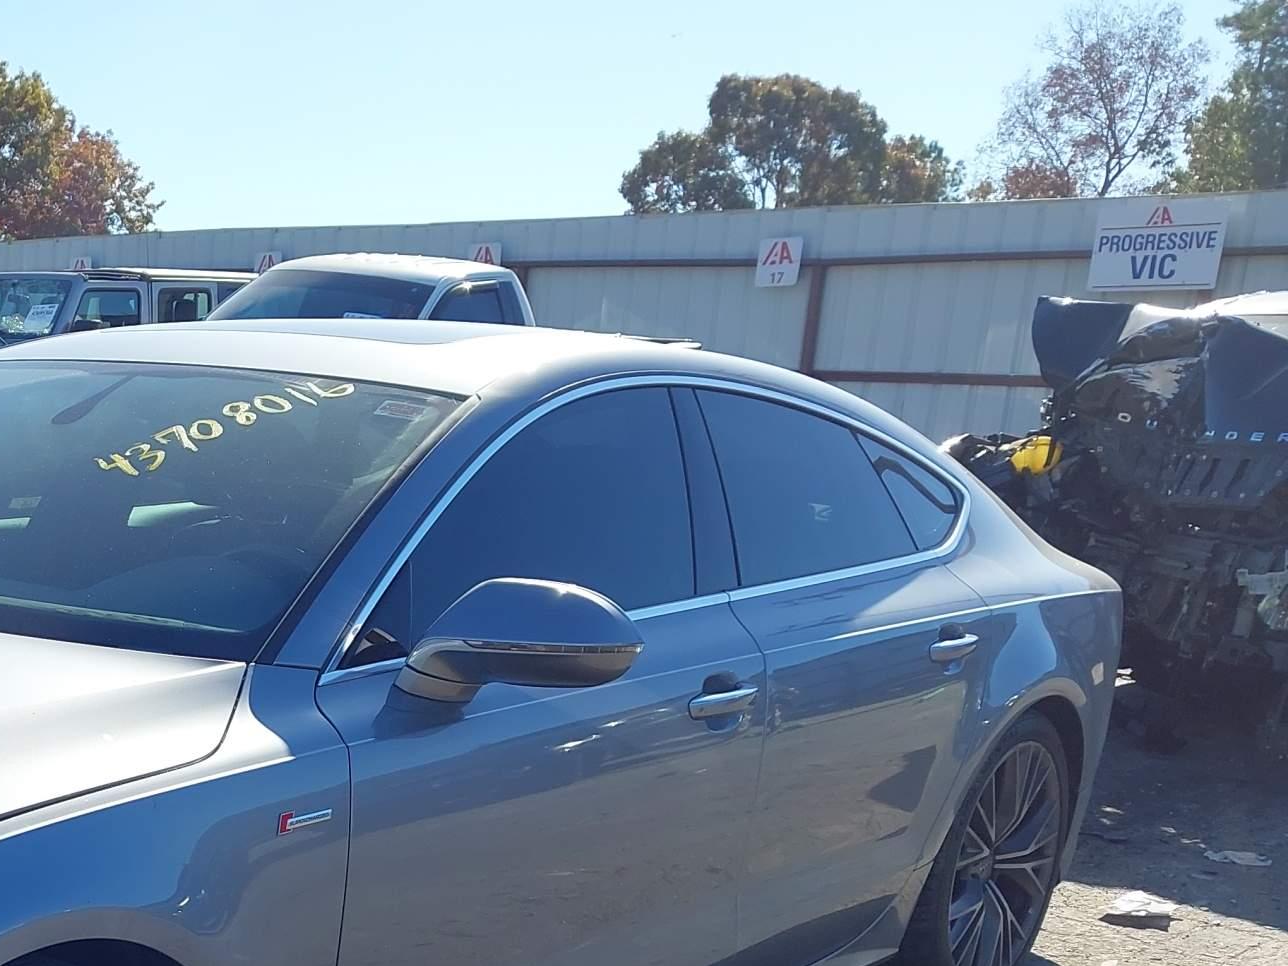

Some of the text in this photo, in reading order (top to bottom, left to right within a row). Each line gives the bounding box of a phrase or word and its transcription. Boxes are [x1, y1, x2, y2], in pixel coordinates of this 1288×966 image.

[1098, 231, 1218, 253] PROGRESSIVE
[770, 271, 785, 284] 17
[1130, 253, 1177, 280] VIC
